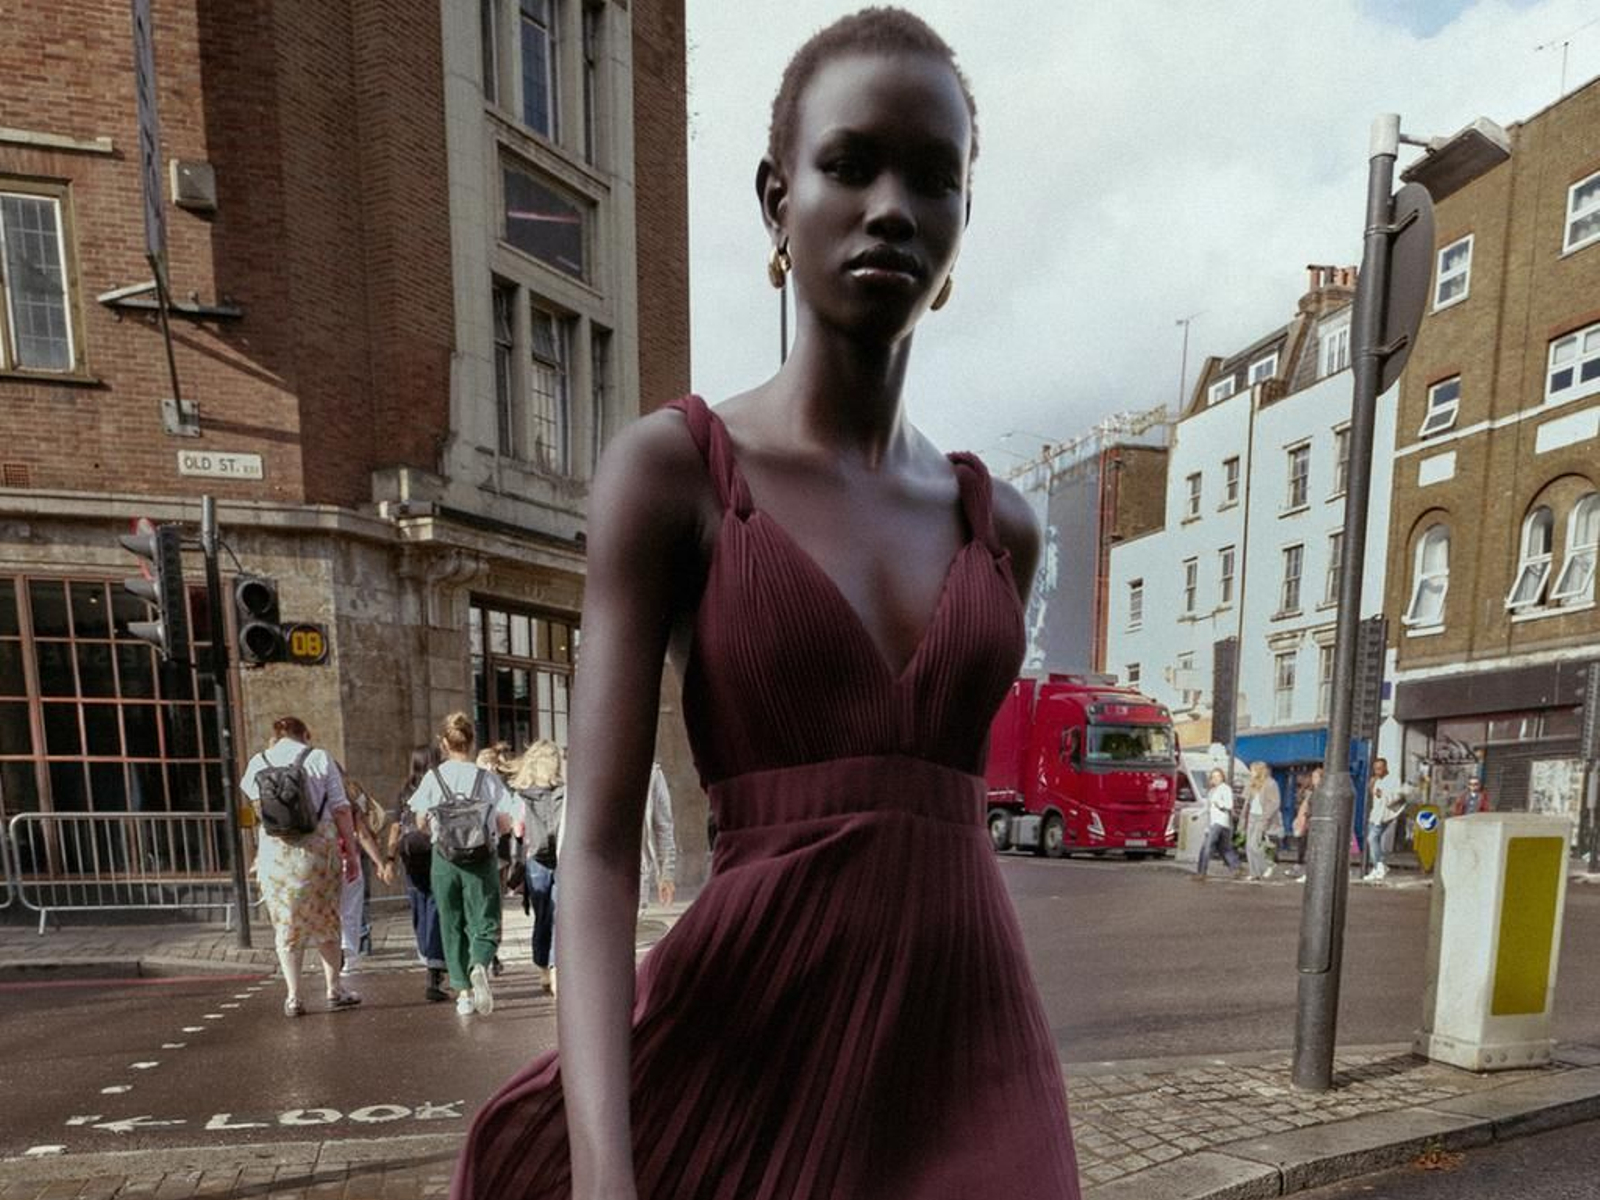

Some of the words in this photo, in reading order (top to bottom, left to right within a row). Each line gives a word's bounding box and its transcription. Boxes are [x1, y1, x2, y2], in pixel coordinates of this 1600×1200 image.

[184, 457, 212, 470] OLD
[292, 631, 322, 656] 08
[205, 1100, 465, 1130] LOOK
